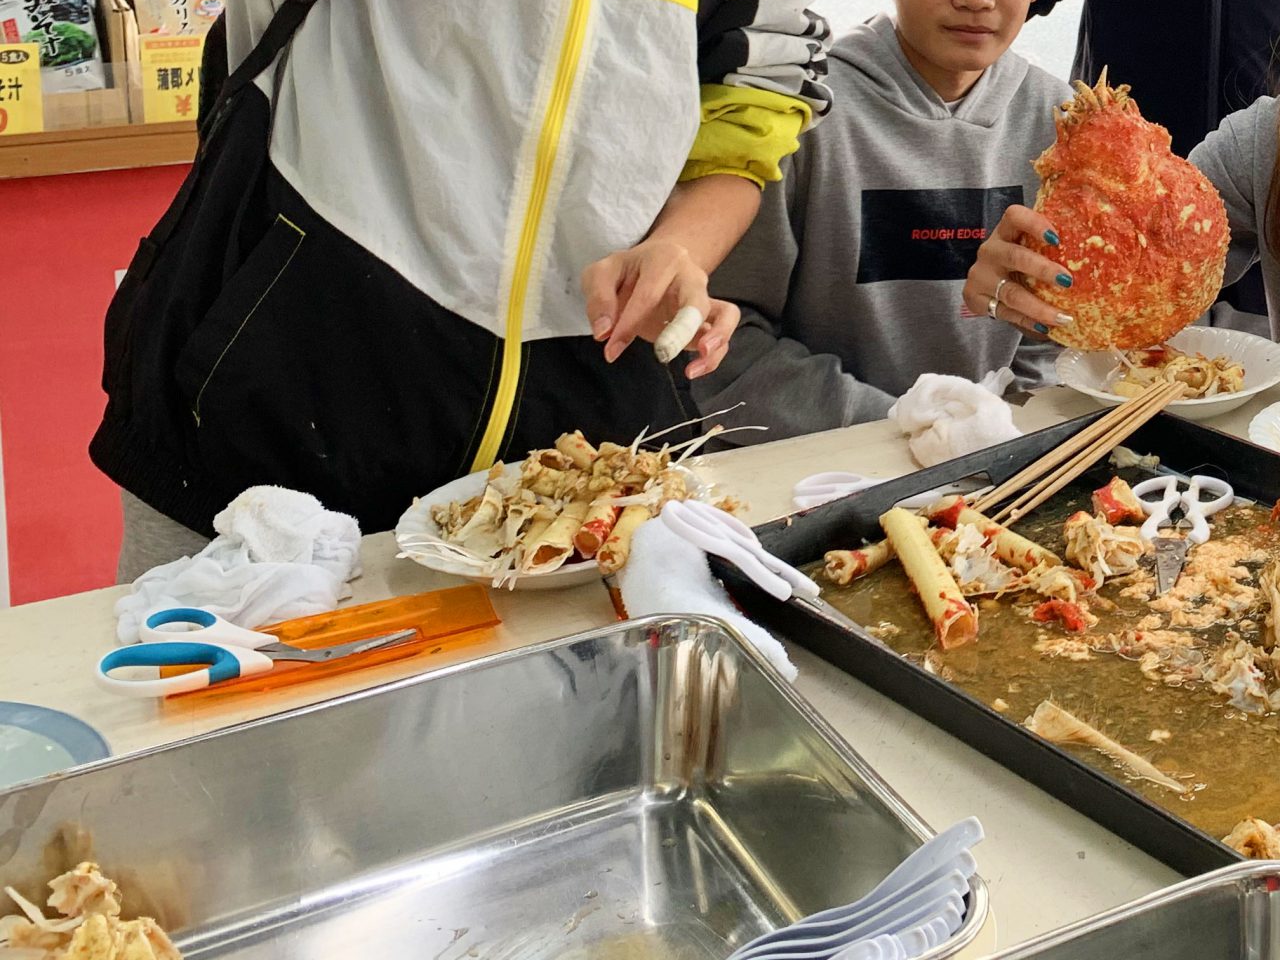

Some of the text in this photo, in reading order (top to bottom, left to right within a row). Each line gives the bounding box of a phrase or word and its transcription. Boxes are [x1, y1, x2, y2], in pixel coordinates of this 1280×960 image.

[157, 67, 200, 90] 蒲郡メ
[912, 228, 986, 240] ROUGH EDGE
